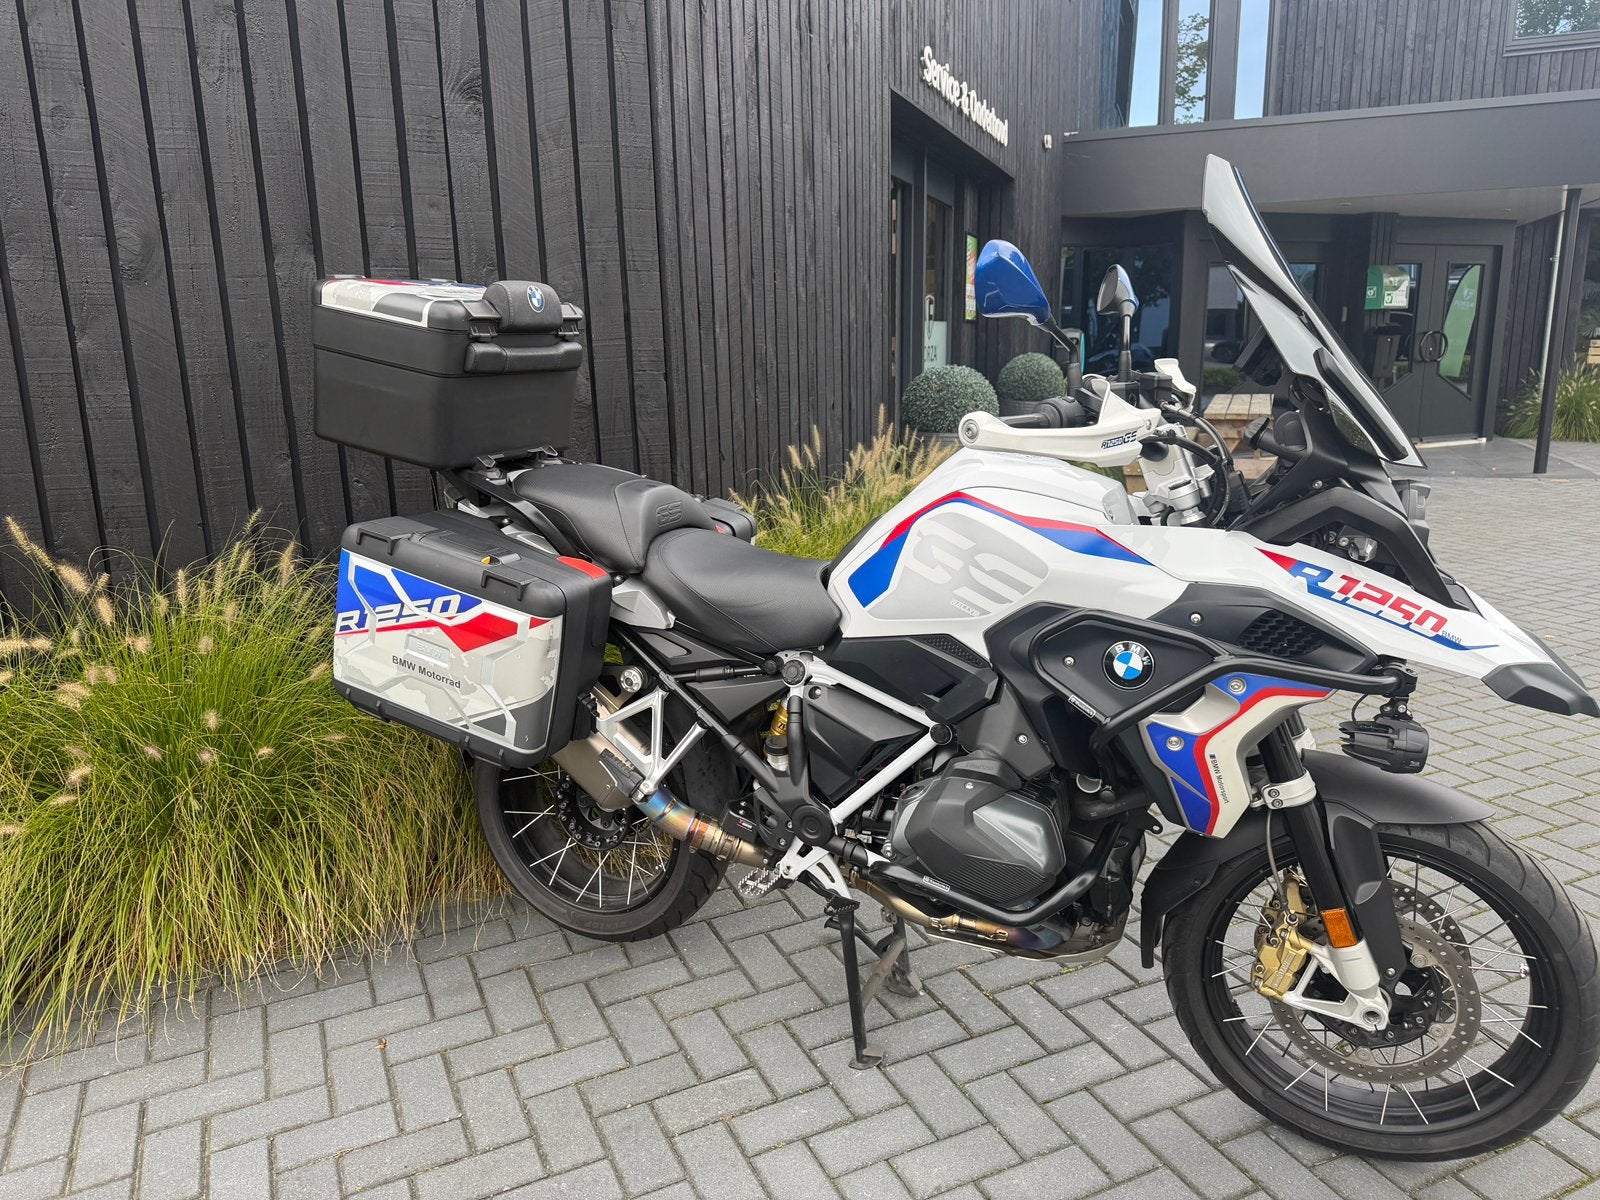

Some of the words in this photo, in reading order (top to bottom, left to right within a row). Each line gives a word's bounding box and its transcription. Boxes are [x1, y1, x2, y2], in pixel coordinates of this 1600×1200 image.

[923, 45, 960, 107] Service
[961, 81, 969, 117] &
[1442, 630, 1463, 644] BMW
[391, 655, 416, 673] BMW
[418, 665, 461, 689] Motorrad
[1211, 760, 1221, 774] BMW
[1216, 775, 1230, 804] Motorsport
